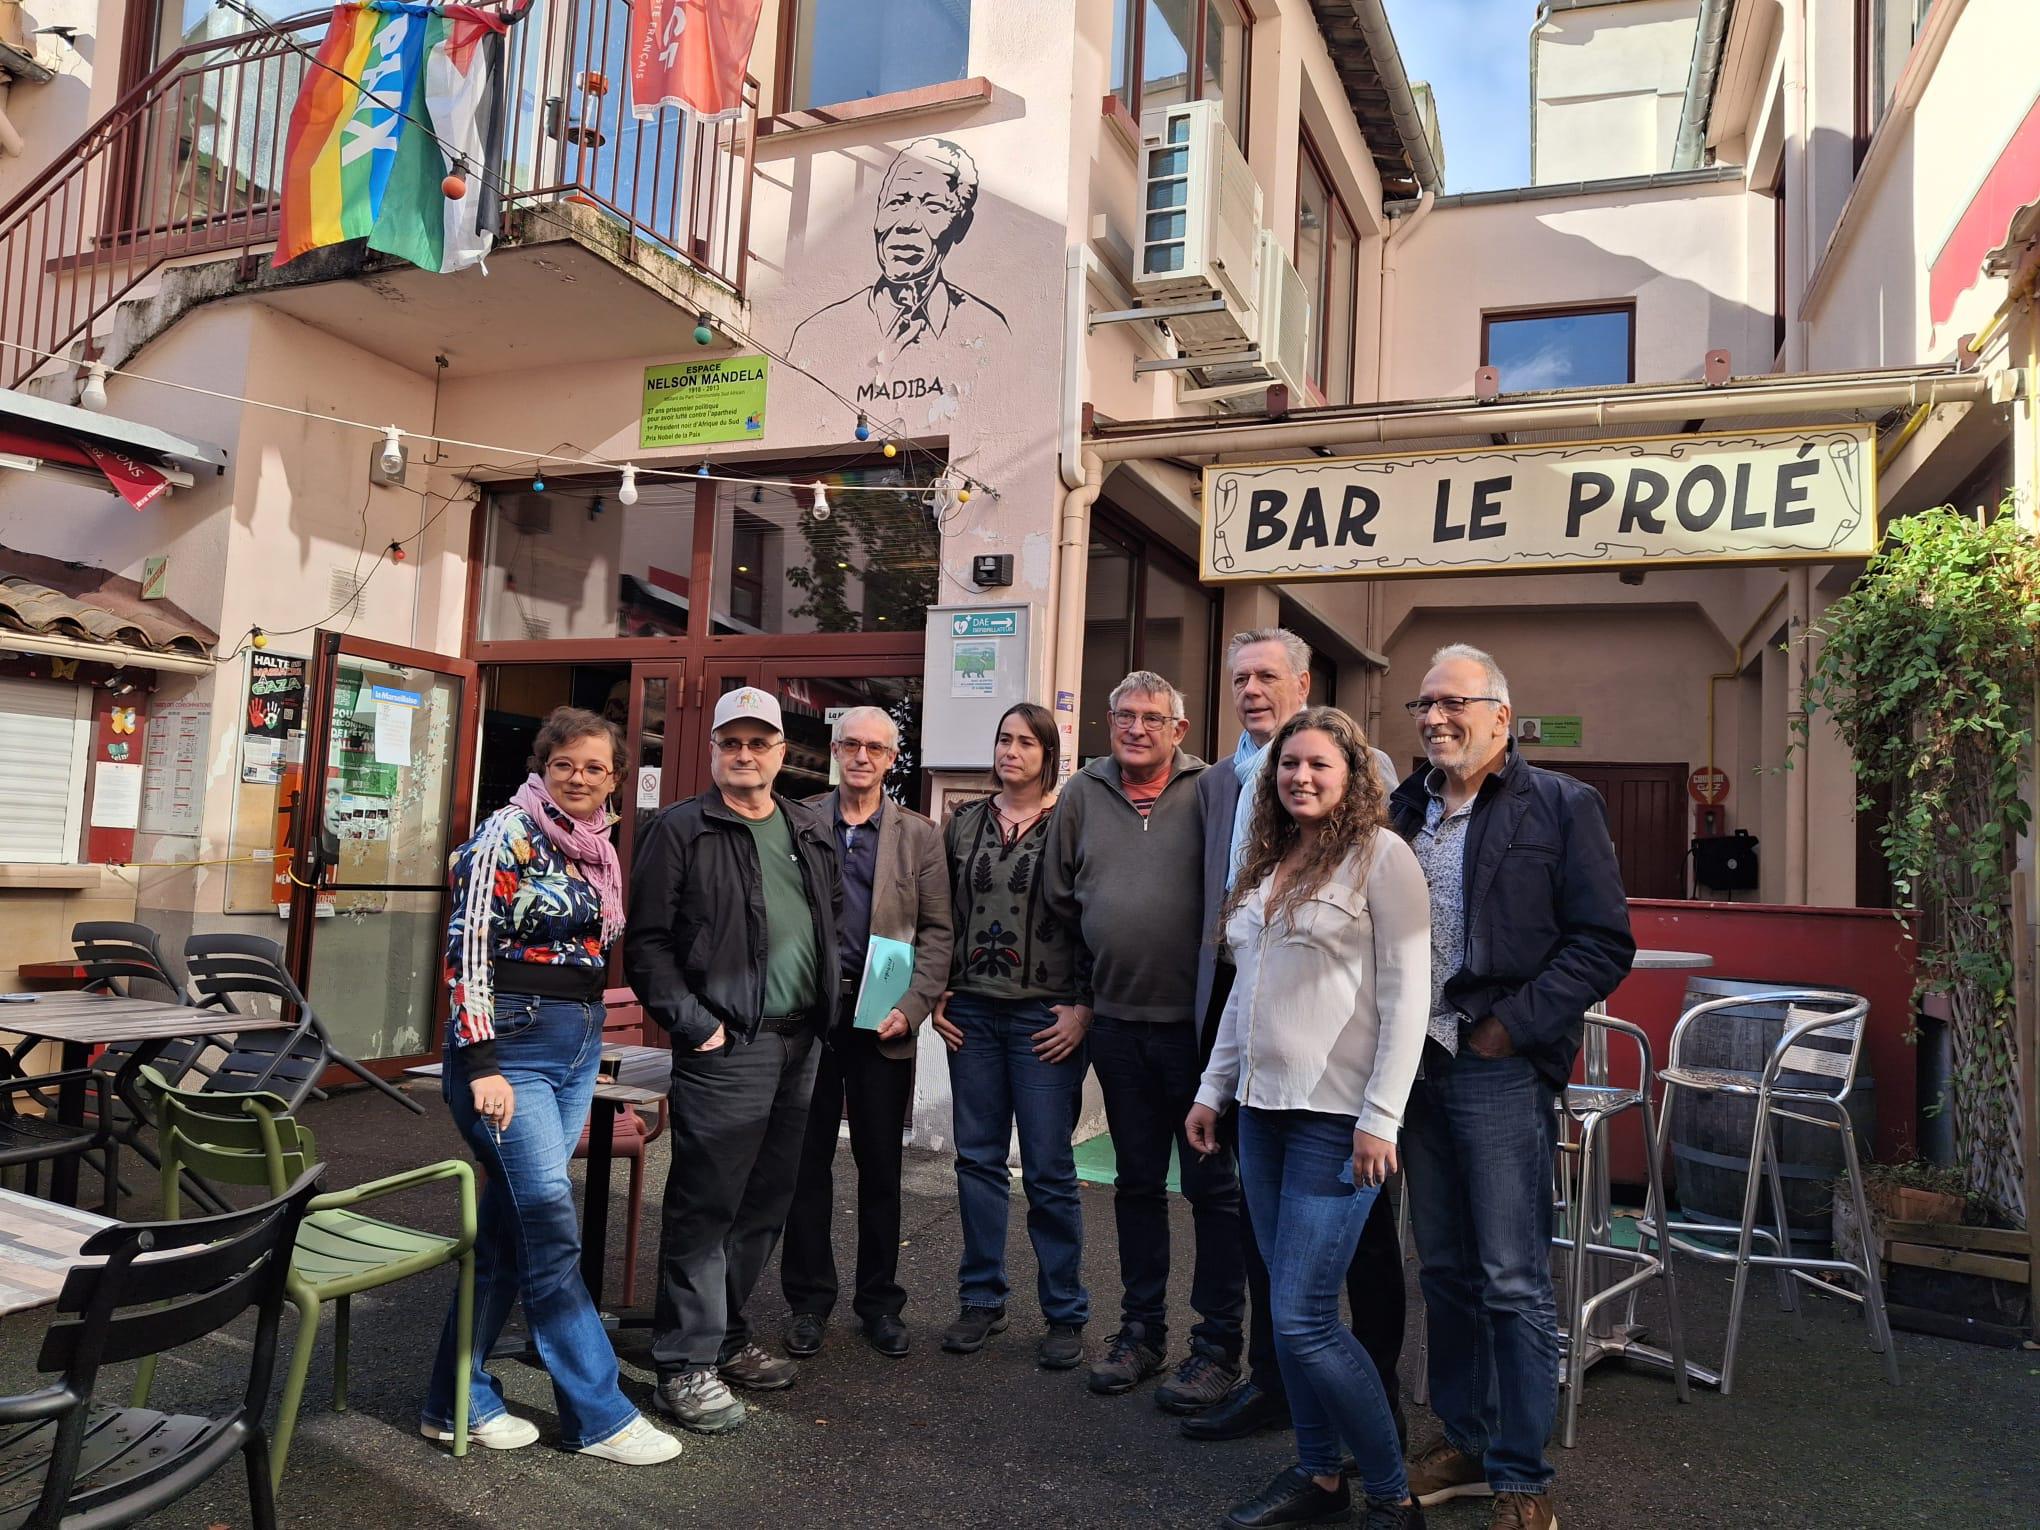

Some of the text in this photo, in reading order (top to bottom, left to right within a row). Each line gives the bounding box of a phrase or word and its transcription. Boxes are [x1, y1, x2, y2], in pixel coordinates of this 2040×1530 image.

[686, 363, 721, 374] ESPACE
[647, 368, 764, 390] NELSON MANDELA
[856, 376, 944, 403] MADIBA
[647, 407, 654, 415] 27
[666, 404, 694, 414] prisonnier
[695, 404, 719, 412] politique
[647, 415, 660, 423] pour
[661, 414, 674, 422] avoir
[675, 412, 687, 420] lutté
[688, 411, 707, 419] contre
[654, 421, 680, 431] Président
[681, 421, 692, 429] noir
[692, 418, 718, 429] d'Afrique
[657, 432, 674, 440] Nobel
[688, 430, 701, 438] Paix
[1244, 442, 1822, 552] BAR LE PROLÉ
[972, 617, 990, 627] DAE
[254, 655, 290, 668] HALTE
[251, 677, 302, 695] GAZA
[375, 690, 418, 704] la Marseillaise
